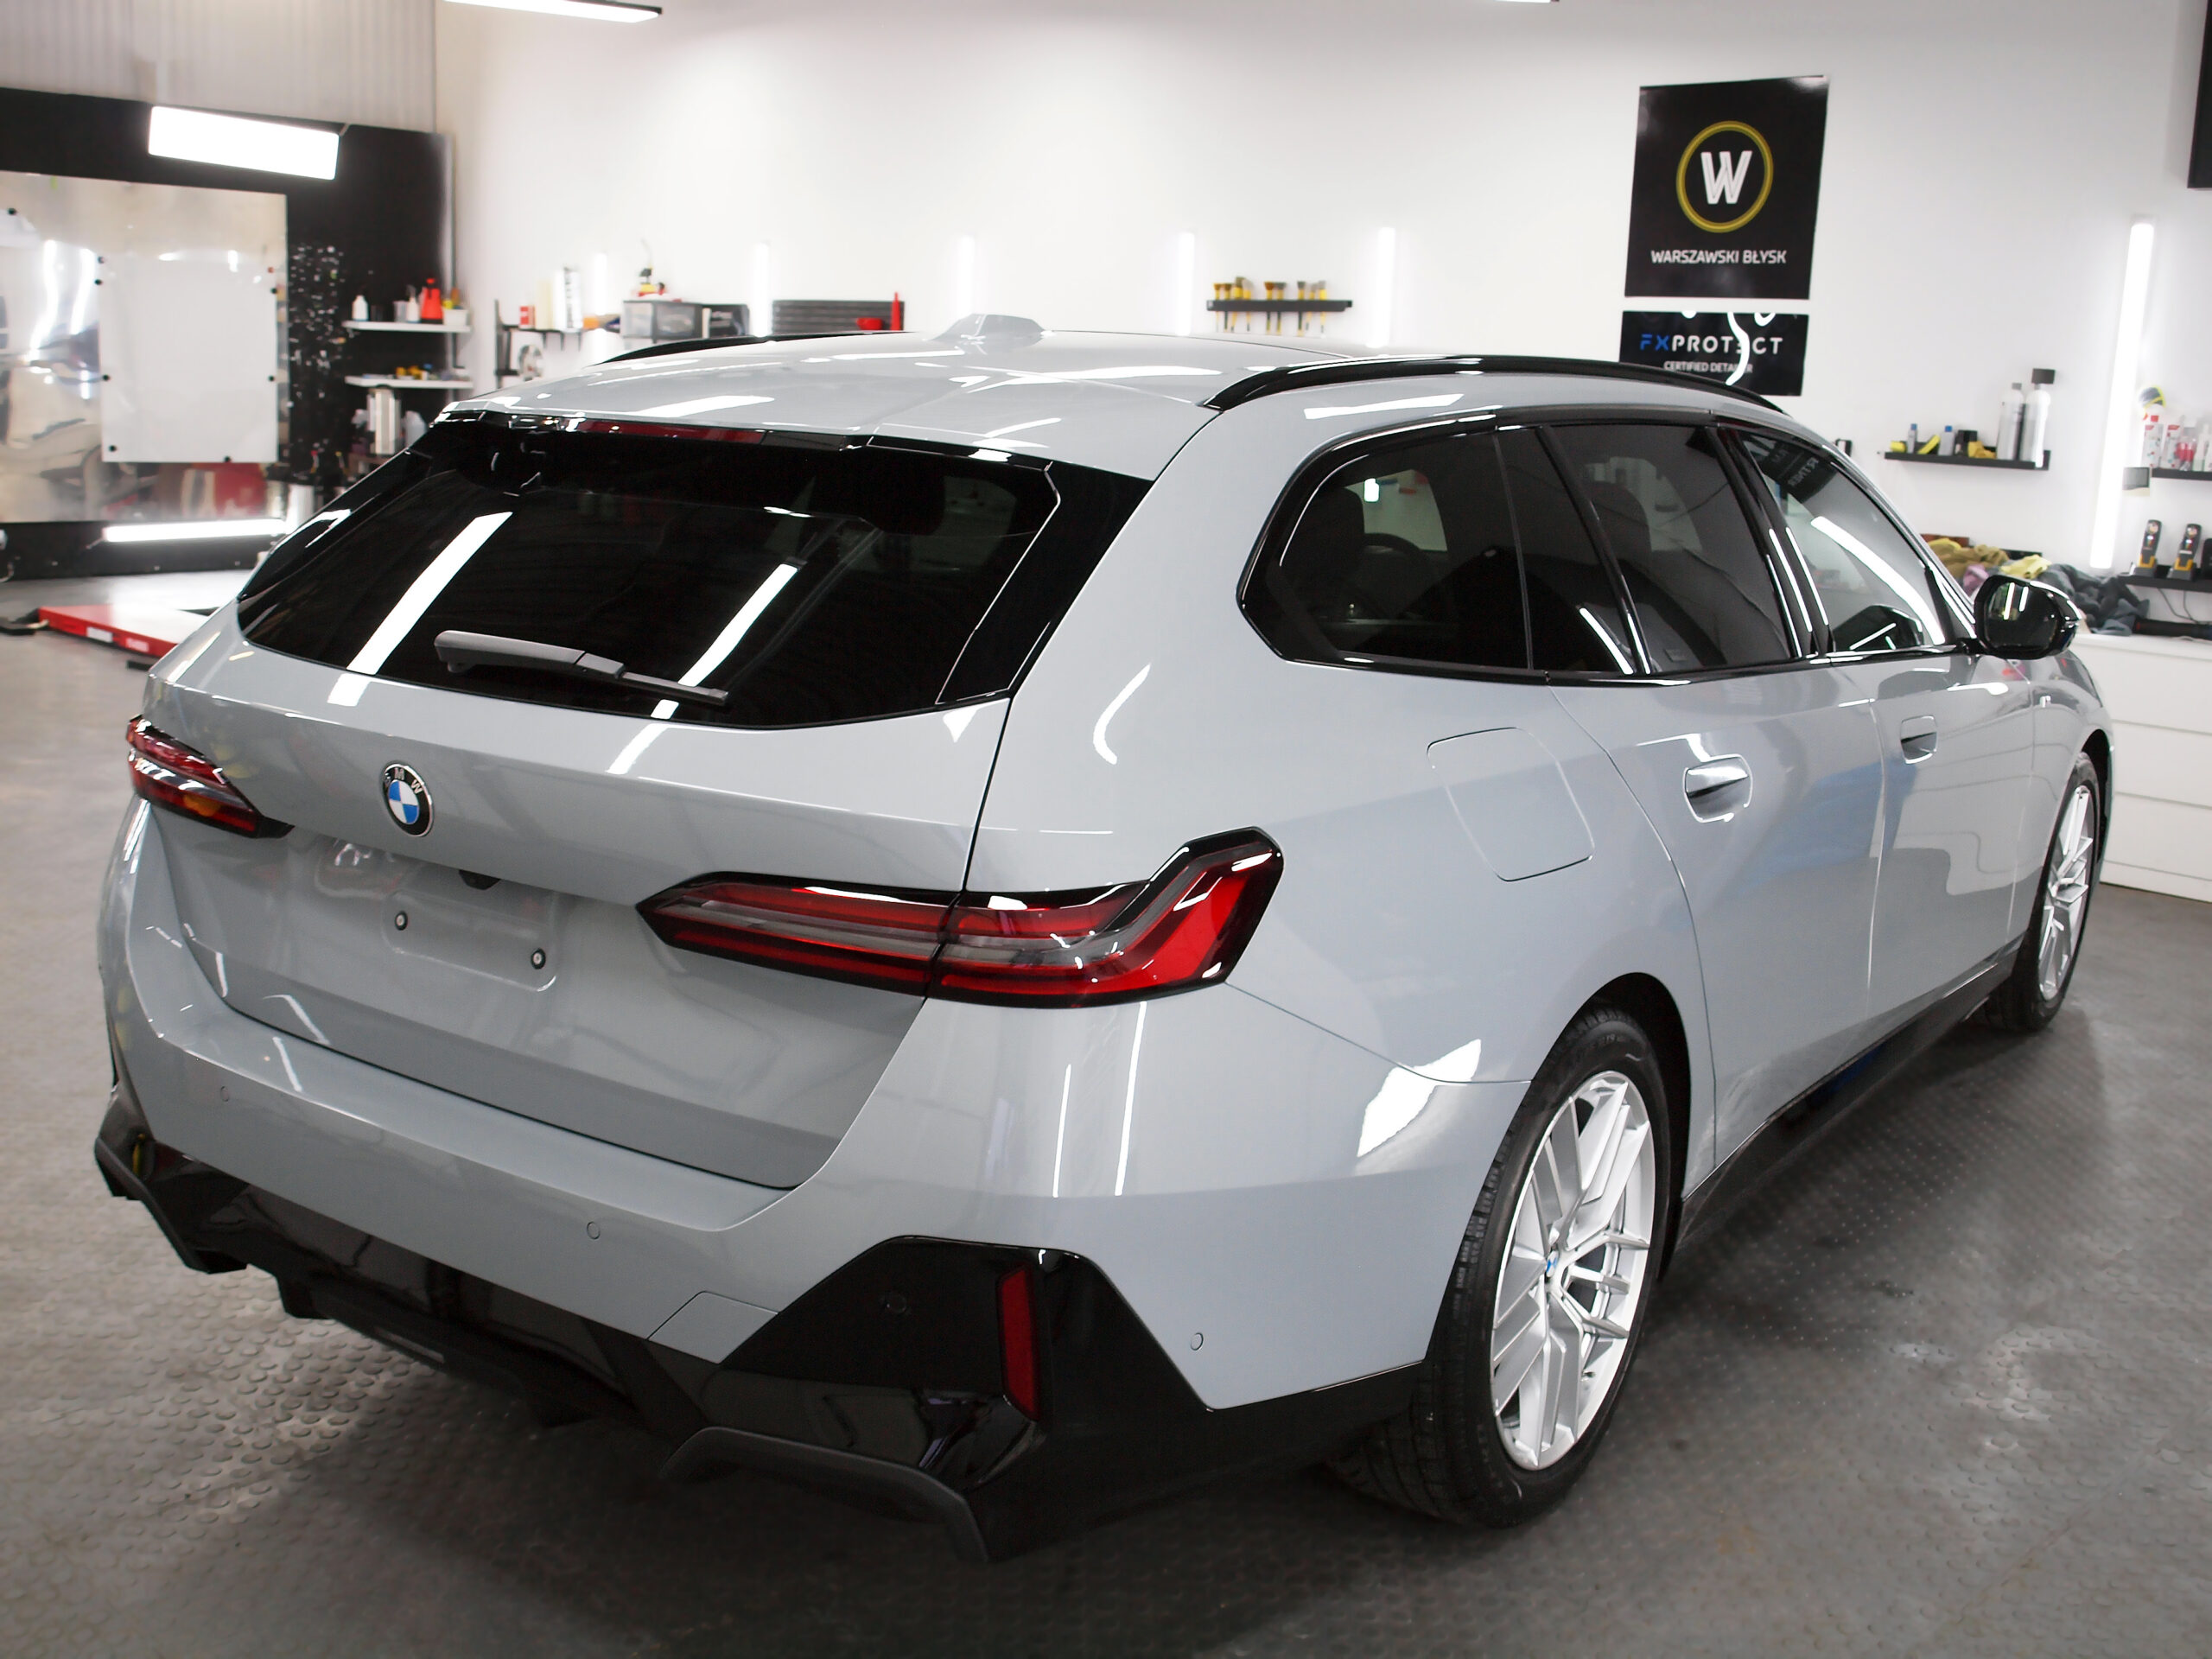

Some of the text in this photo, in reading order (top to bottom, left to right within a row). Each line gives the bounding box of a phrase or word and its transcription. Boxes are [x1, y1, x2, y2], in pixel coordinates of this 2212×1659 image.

[1700, 149, 1753, 205] W
[1650, 249, 1788, 264] WARSZAWSKI BŁYSK
[1663, 360, 1709, 373] CERTIFIED
